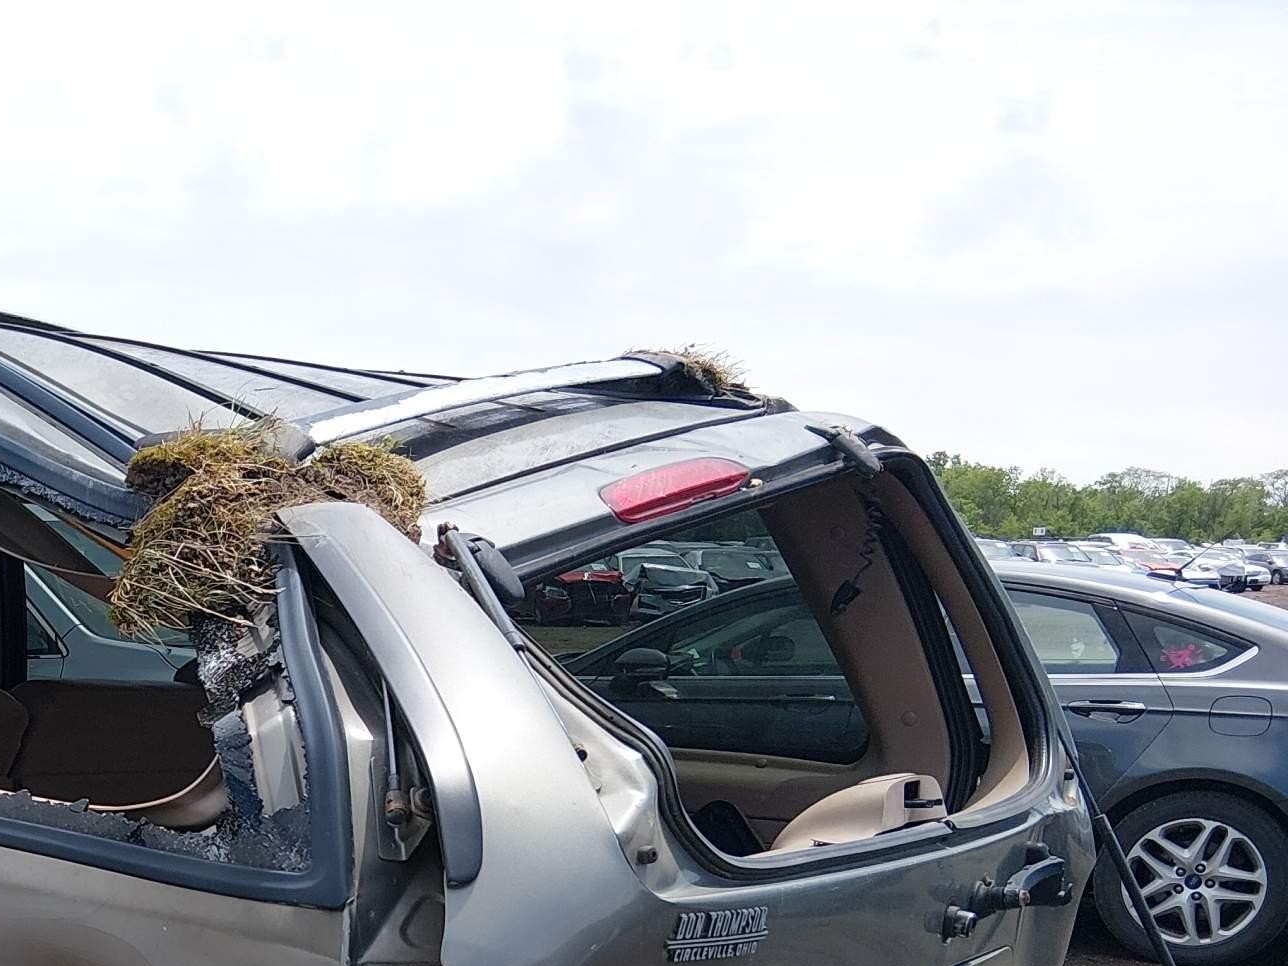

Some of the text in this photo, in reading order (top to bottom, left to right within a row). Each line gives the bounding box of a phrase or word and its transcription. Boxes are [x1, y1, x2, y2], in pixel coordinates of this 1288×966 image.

[676, 906, 768, 940] DON THOMPSON
[735, 941, 758, 957] OHIO
